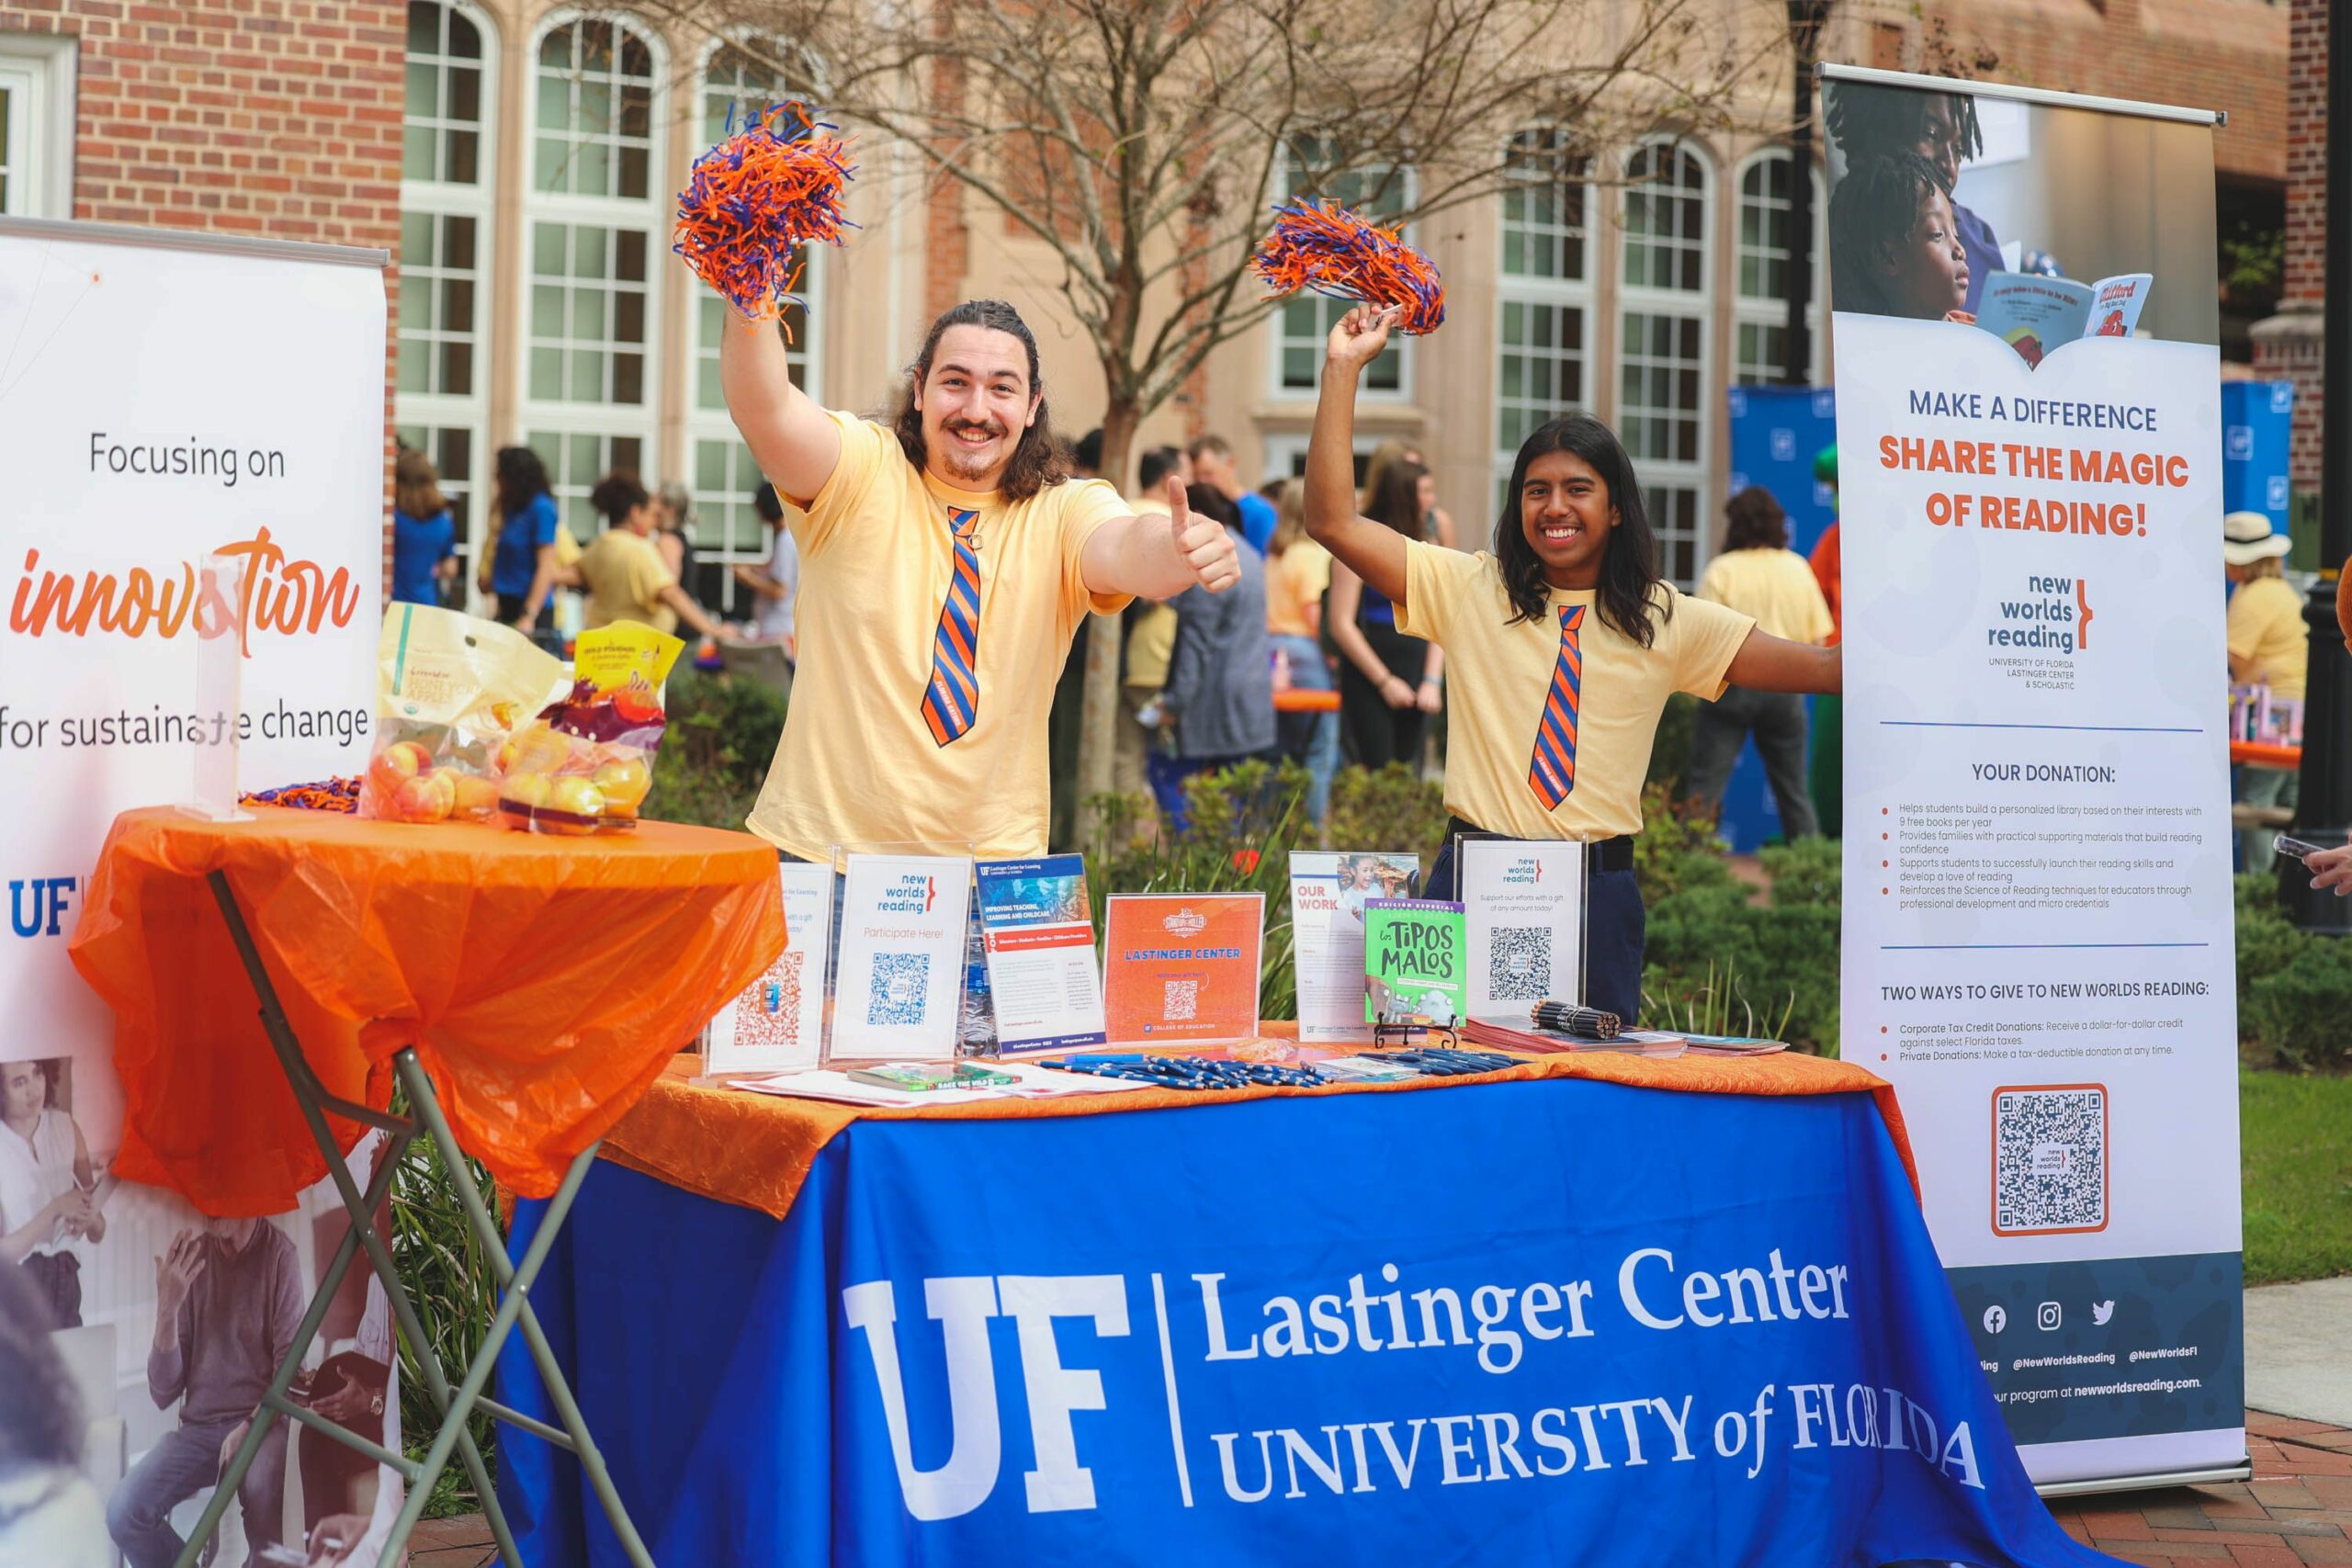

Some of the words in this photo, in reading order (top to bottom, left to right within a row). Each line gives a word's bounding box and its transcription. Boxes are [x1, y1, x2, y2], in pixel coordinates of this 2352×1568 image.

[1909, 389, 1982, 419] MAKE
[1990, 396, 2007, 420] A
[2014, 398, 2157, 432] DIFFERENCE
[90, 433, 237, 487] Focusing
[248, 449, 285, 478] on
[1879, 434, 1996, 475] SHARE
[2002, 444, 2064, 480] THE
[2070, 449, 2188, 488] MAGIC
[1926, 492, 1973, 527] OF
[1981, 495, 2146, 537] READING!
[2030, 576, 2071, 594] new
[2000, 598, 2073, 622] worlds
[1988, 625, 2073, 654] reading
[1988, 658, 2033, 667] UNIVERSITY
[2035, 659, 2045, 667] OF
[2046, 660, 2074, 669] FLORIDA
[2007, 670, 2047, 678] LASTINGER
[2049, 671, 2075, 679] CENTER
[2032, 681, 2075, 690] SCHOLASTIC
[0, 705, 50, 749] for
[262, 698, 368, 747] change
[1972, 763, 2020, 781] YOUR
[2026, 764, 2116, 783] DONATION:
[1899, 804, 1923, 815] Helps
[1926, 804, 1964, 813] students
[1966, 805, 1988, 814] build
[1998, 805, 2055, 816] personalized
[2056, 805, 2082, 817] library
[2083, 806, 2109, 815] based
[2123, 807, 2143, 816] their
[2145, 807, 2183, 816] interests
[2185, 807, 2202, 816] with
[1899, 817, 1905, 826] 9
[1907, 817, 1924, 826] free
[1926, 817, 1952, 827] books
[1954, 818, 1970, 829] per
[1973, 819, 1992, 829] year
[1899, 831, 1937, 840] Provides
[1938, 831, 1973, 840] families
[1975, 831, 1994, 840] with
[1996, 831, 2036, 843] practical
[2038, 832, 2083, 843] supporting
[2085, 832, 2123, 841] materials
[2125, 833, 2143, 841] that
[2145, 833, 2167, 842] build
[2169, 833, 2202, 844] reading
[1899, 844, 1949, 853] confidence
[1899, 858, 1939, 869] Supports
[1940, 859, 1980, 868] students
[1982, 860, 1991, 868] to
[1993, 858, 2047, 870] successfully
[2049, 859, 2077, 868] launch
[2079, 859, 2097, 868] their
[2098, 860, 2131, 871] reading
[2132, 859, 2154, 868] skills
[2155, 859, 2174, 868] and
[901, 874, 926, 885] new
[1503, 874, 1534, 884] reading
[1899, 872, 1936, 883] develop
[1945, 872, 1964, 881] love
[1966, 872, 1975, 881] of
[1977, 873, 2013, 884] reading
[886, 887, 925, 897] worlds
[1298, 886, 1325, 897] OUR
[1899, 886, 1945, 895] Reinforces
[1947, 886, 1962, 895] the
[1964, 886, 2000, 895] Science
[2001, 886, 2012, 895] of
[2013, 886, 2050, 897] Reading
[2052, 886, 2097, 897] techniques
[2098, 886, 2109, 895] for
[2111, 886, 2155, 895] educators
[2157, 886, 2191, 897] through
[8, 876, 76, 938] UF
[877, 900, 923, 914] reading
[1298, 899, 1338, 909] WORK
[1899, 899, 1954, 911] professional
[1956, 899, 2016, 910] development
[2018, 899, 2036, 908] and
[2038, 899, 2064, 908] micro
[2064, 899, 2109, 908] credentials
[864, 927, 916, 942] Participate
[919, 929, 944, 939] Here!
[1125, 949, 1193, 960] LASTINGER
[1195, 948, 1240, 958] CENTER
[1382, 947, 1453, 978] MALOS
[1882, 986, 1917, 1000] TWO
[1920, 985, 1962, 999] WAYS
[1966, 985, 1986, 998] TO
[1990, 985, 2023, 998] GIVE
[2027, 984, 2047, 998] TO
[2051, 984, 2082, 998] NEW
[2085, 983, 2141, 997] WORLDS
[2144, 982, 2210, 996] READING:
[1899, 1024, 1946, 1036] Corporate
[1948, 1023, 1963, 1032] Tax
[1965, 1022, 1994, 1032] Credit
[1996, 1022, 2044, 1032] Donations:
[2046, 1021, 2079, 1031] Receive
[2089, 1020, 2156, 1030] dollar-for-dollar
[2157, 1018, 2184, 1029] credit
[1899, 1038, 1934, 1050] against
[1936, 1037, 1962, 1047] select
[1964, 1036, 1996, 1046] Florida
[1899, 1052, 1930, 1061] Private
[1933, 1051, 1982, 1061] Donations:
[1984, 1050, 2007, 1059] Make
[2018, 1047, 2084, 1058] tax-deductible
[2085, 1046, 2122, 1056] donation
[2123, 1046, 2132, 1055] at
[2134, 1047, 2151, 1057] any
[2152, 1045, 2174, 1055] time.
[1192, 1263, 1594, 1374] Lastinger
[1618, 1247, 1849, 1330] Center
[2013, 1353, 2116, 1371] @NewWorldsReading
[842, 1274, 1131, 1521] UF
[2009, 1387, 2058, 1404] program
[2061, 1386, 2073, 1398] at
[2075, 1378, 2201, 1398] newworldsreading.com.
[1210, 1394, 1696, 1504] UNIVERSITY
[1714, 1383, 1775, 1479] of
[1788, 1382, 1985, 1490] FLORIDA
